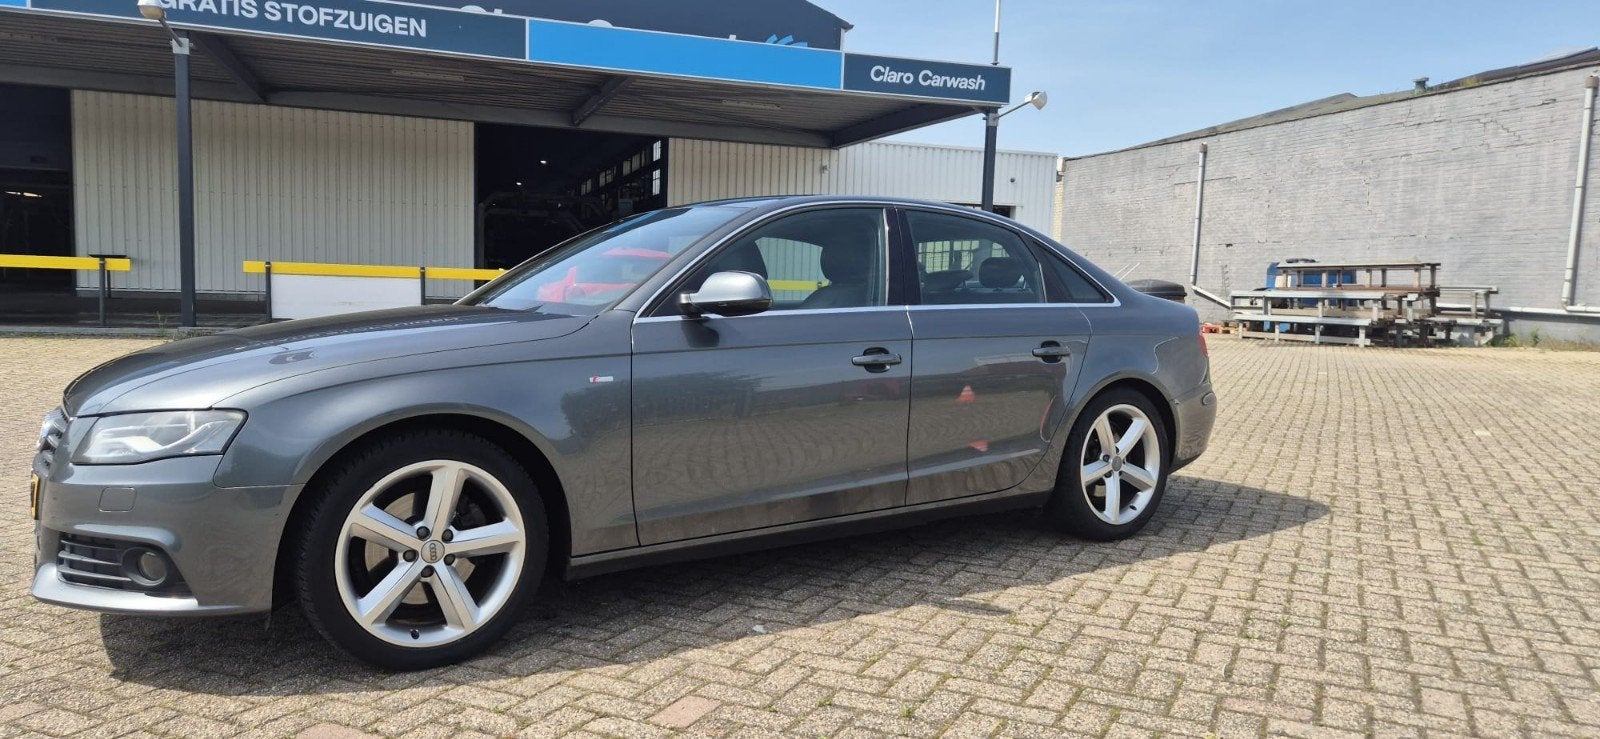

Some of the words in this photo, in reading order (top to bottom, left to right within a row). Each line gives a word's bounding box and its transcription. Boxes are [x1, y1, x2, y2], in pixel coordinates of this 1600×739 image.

[264, 1, 427, 37] STOFZUIGEN
[870, 65, 914, 84] Claro
[918, 69, 986, 91] Carwash
